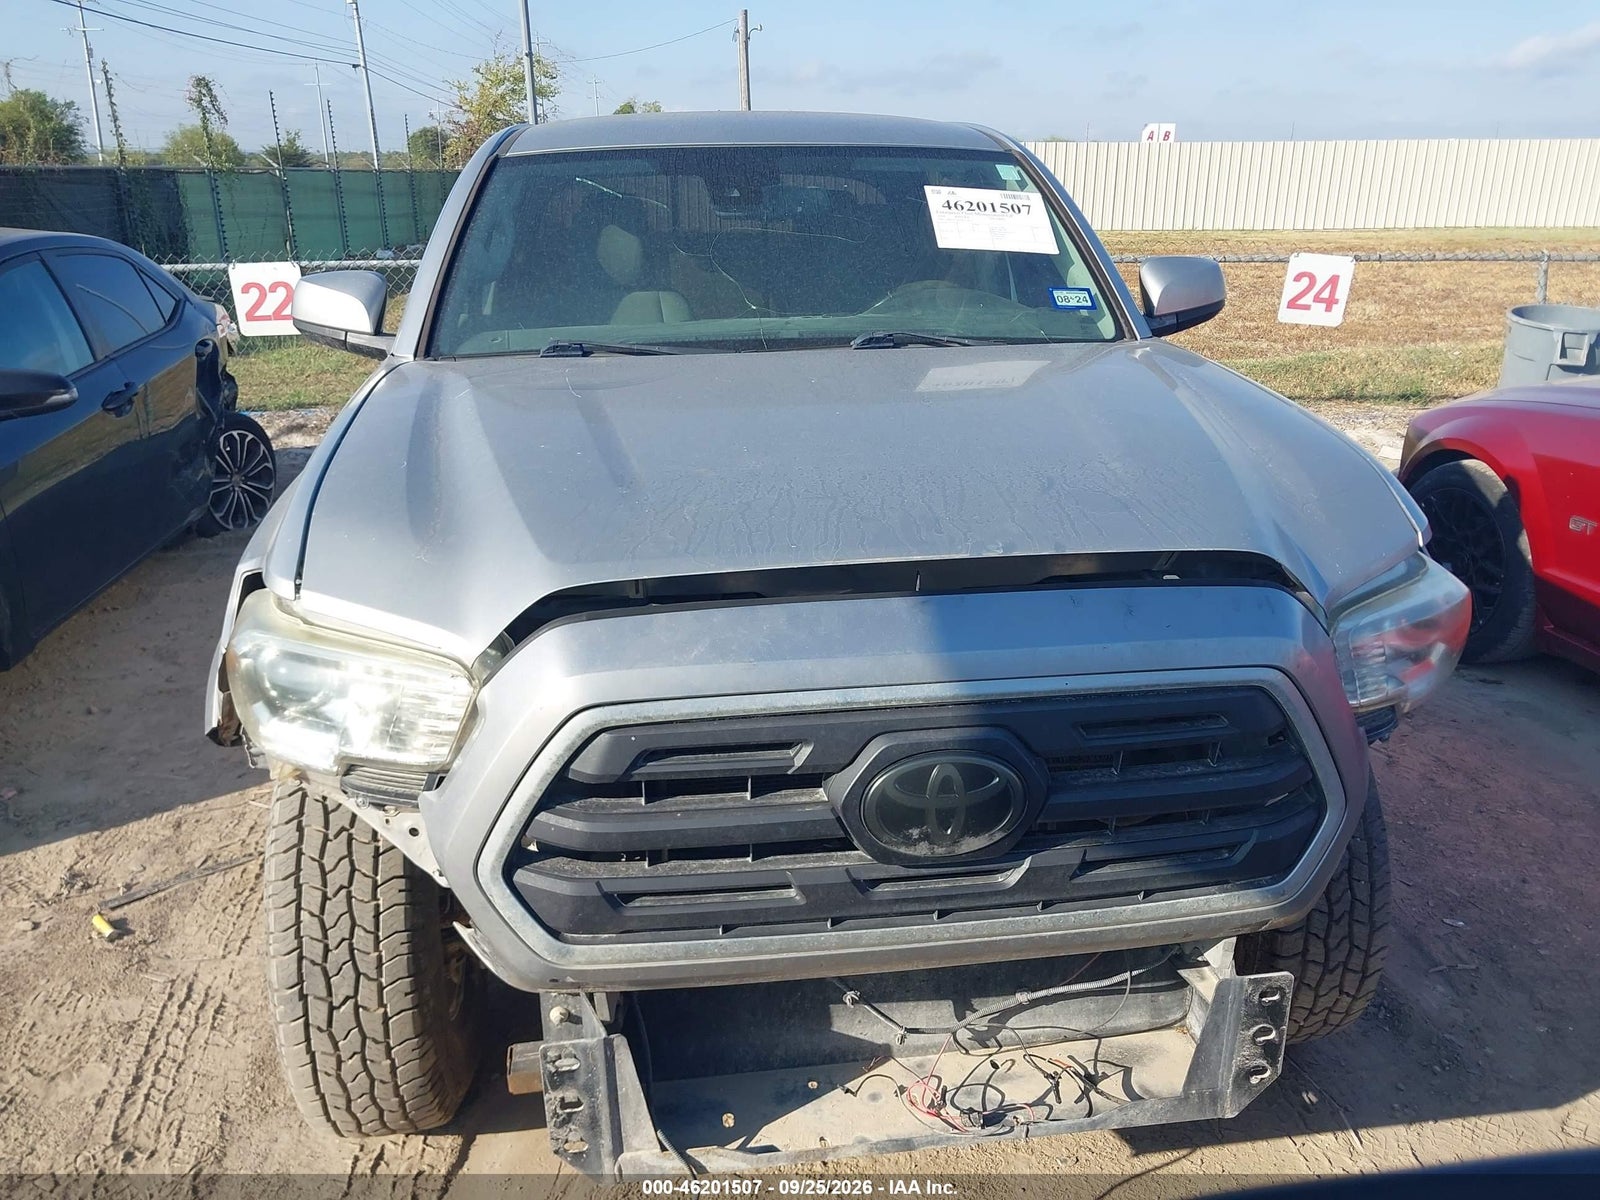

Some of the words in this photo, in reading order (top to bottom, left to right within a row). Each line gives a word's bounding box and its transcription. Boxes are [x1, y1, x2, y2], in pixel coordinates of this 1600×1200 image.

[1146, 130, 1154, 141] A
[1162, 130, 1171, 141] B
[941, 199, 1031, 215] 46201507
[241, 281, 294, 321] 22
[1286, 271, 1340, 312] 24
[1569, 515, 1598, 536] GT
